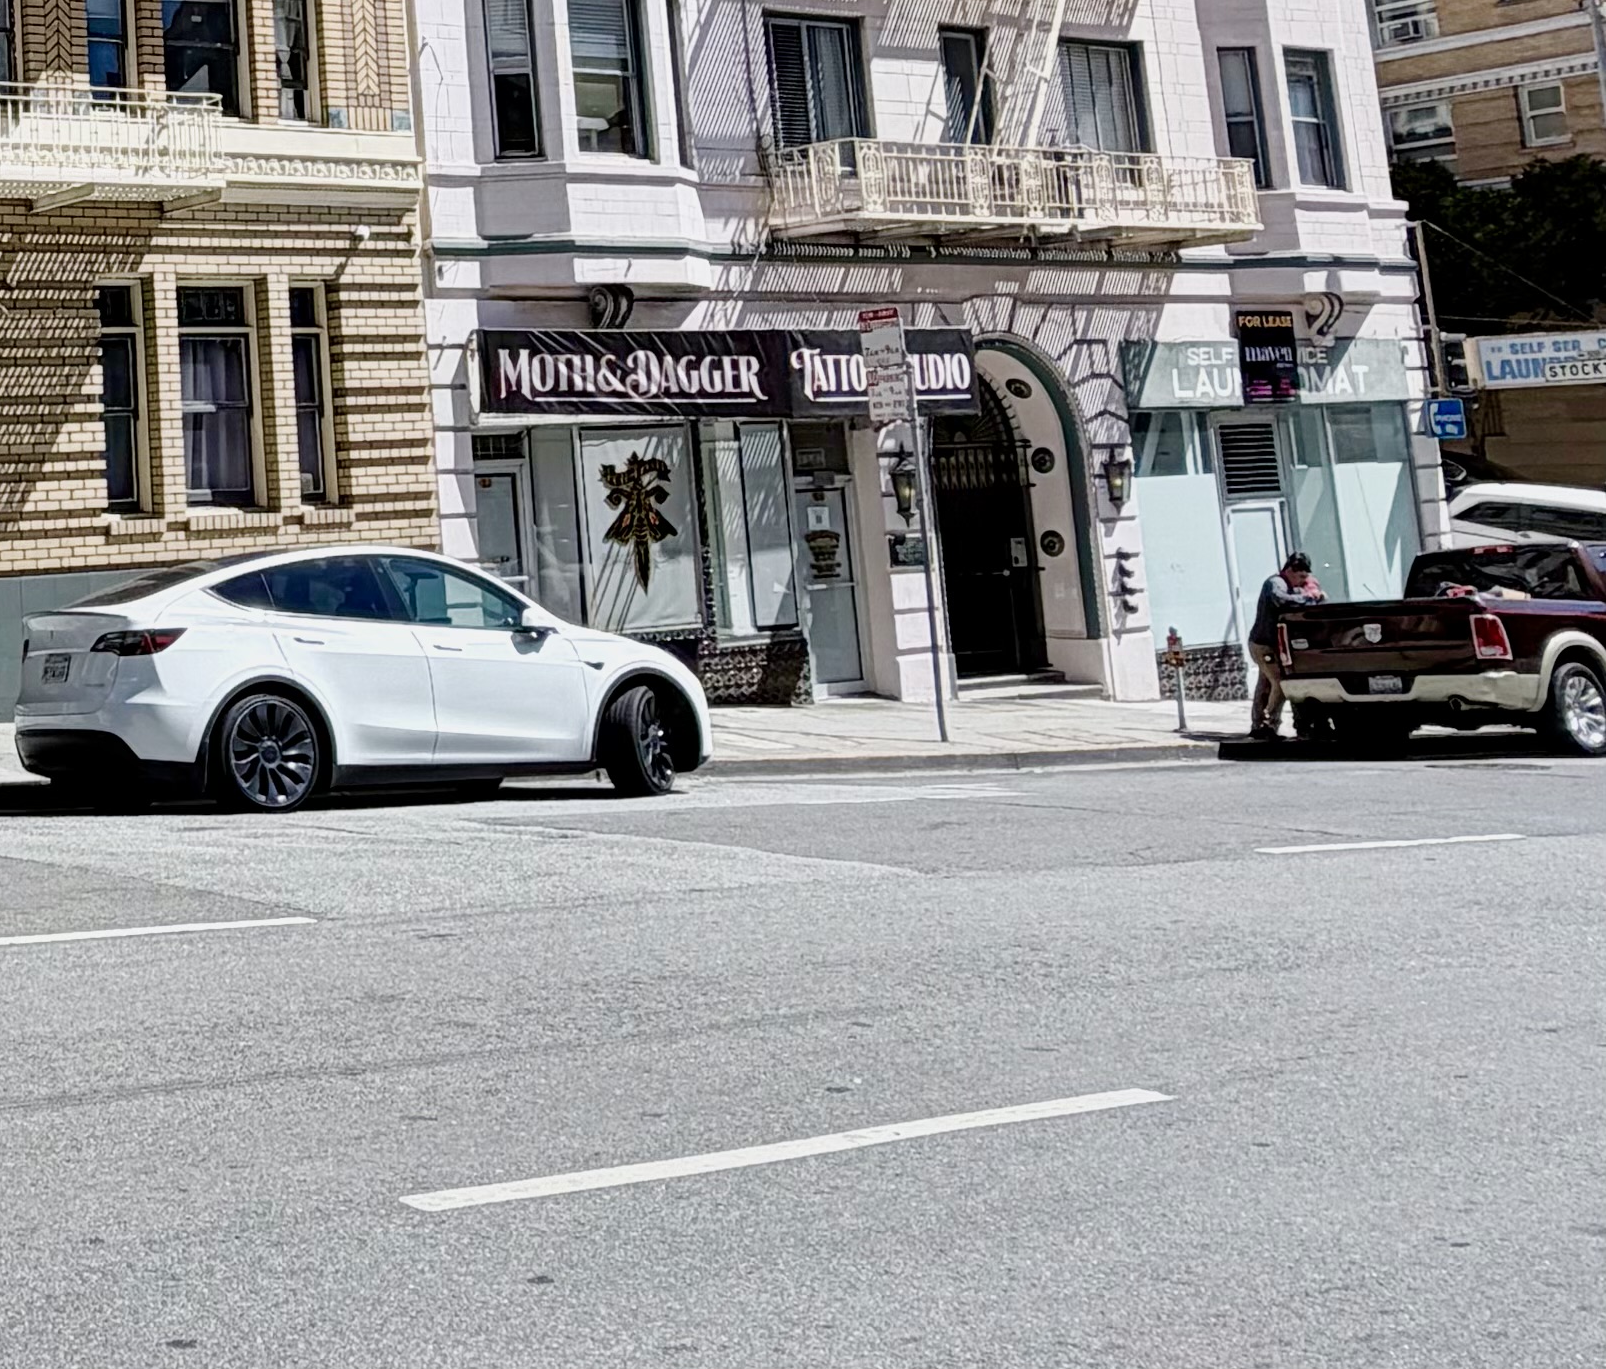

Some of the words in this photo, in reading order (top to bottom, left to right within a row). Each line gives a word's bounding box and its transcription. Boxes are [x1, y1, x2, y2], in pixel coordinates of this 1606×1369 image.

[1238, 315, 1262, 328] FOR
[1262, 315, 1292, 328] LEASE
[1245, 346, 1293, 362] maven
[1509, 341, 1546, 355] SELF
[1187, 347, 1234, 366] SELF
[790, 347, 868, 402] TATTO
[911, 352, 971, 392] UDIO
[1548, 362, 1606, 378] STOCK
